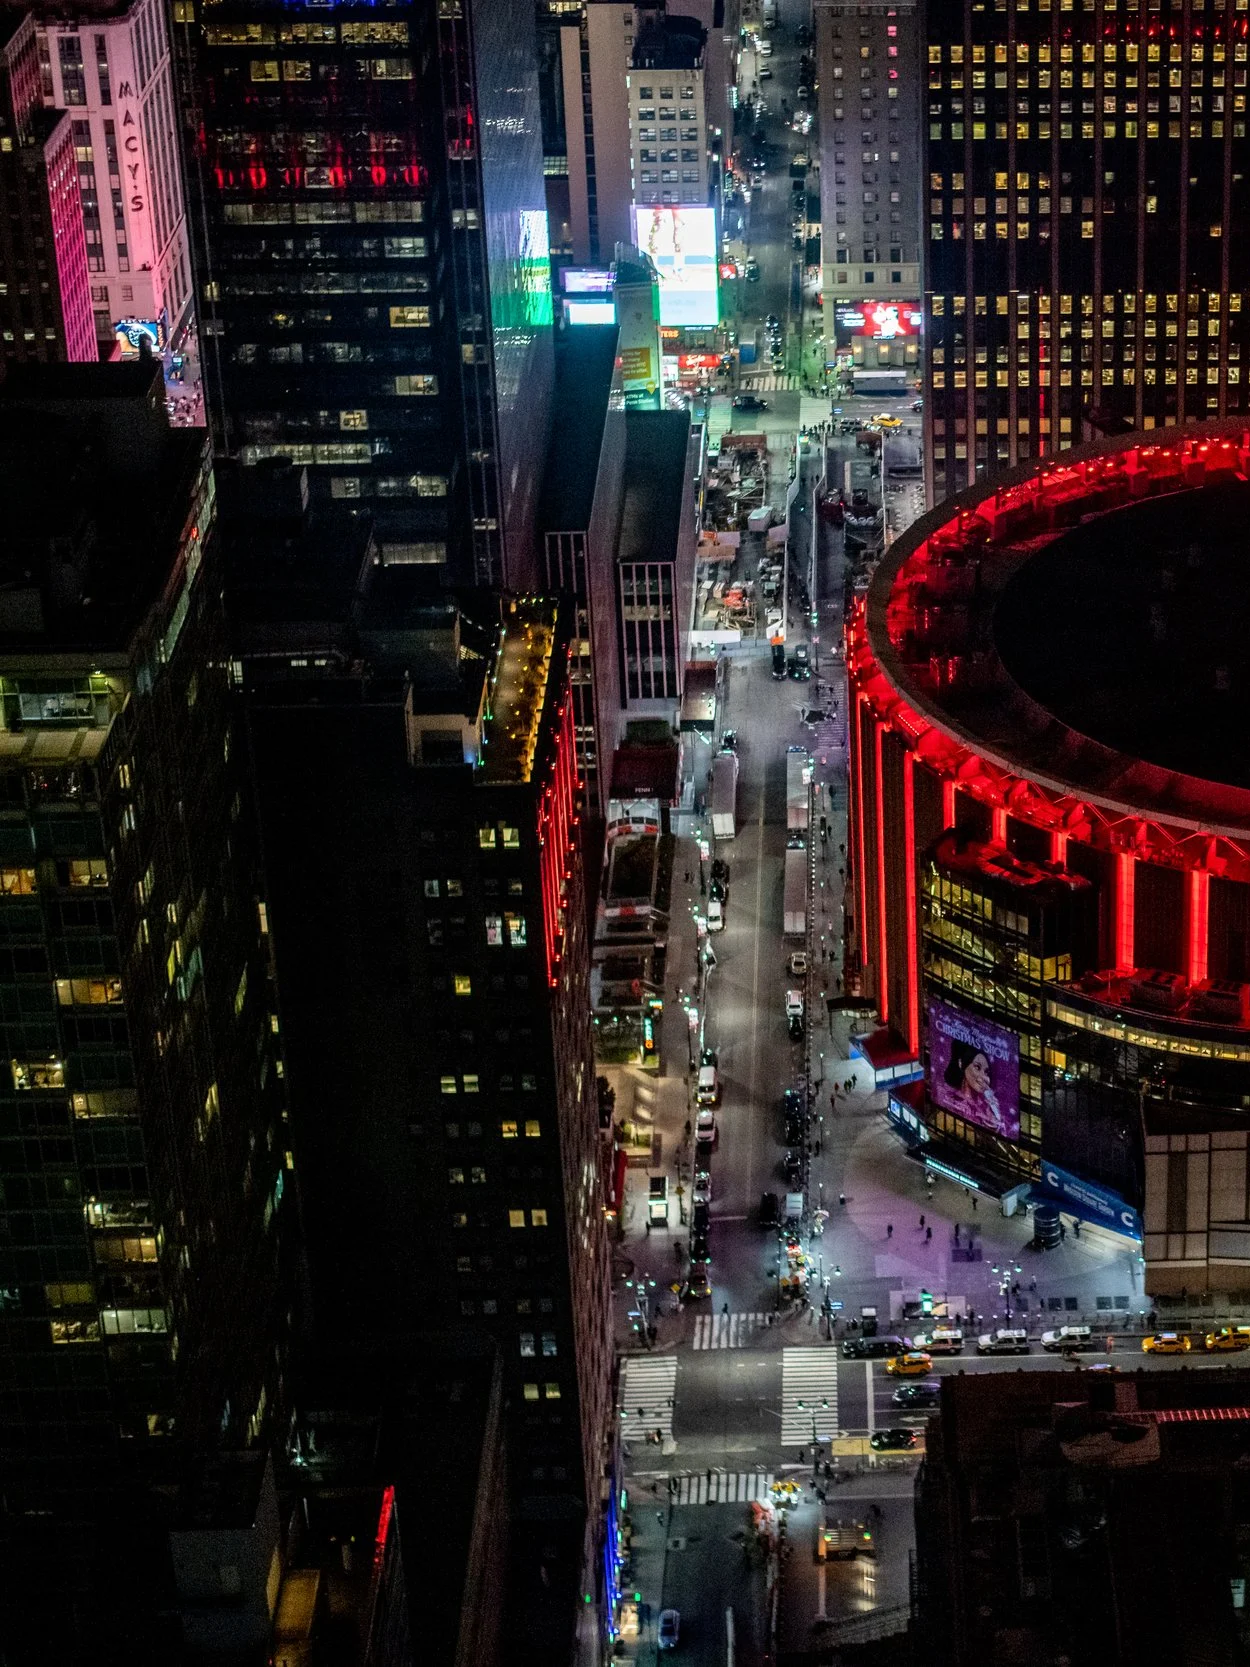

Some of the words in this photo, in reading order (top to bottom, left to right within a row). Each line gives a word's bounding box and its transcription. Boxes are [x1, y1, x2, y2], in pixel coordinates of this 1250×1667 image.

[118, 80, 144, 212] MACY'S
[935, 1020, 981, 1050] CHRISTMAS
[983, 1043, 1010, 1061] SHOW
